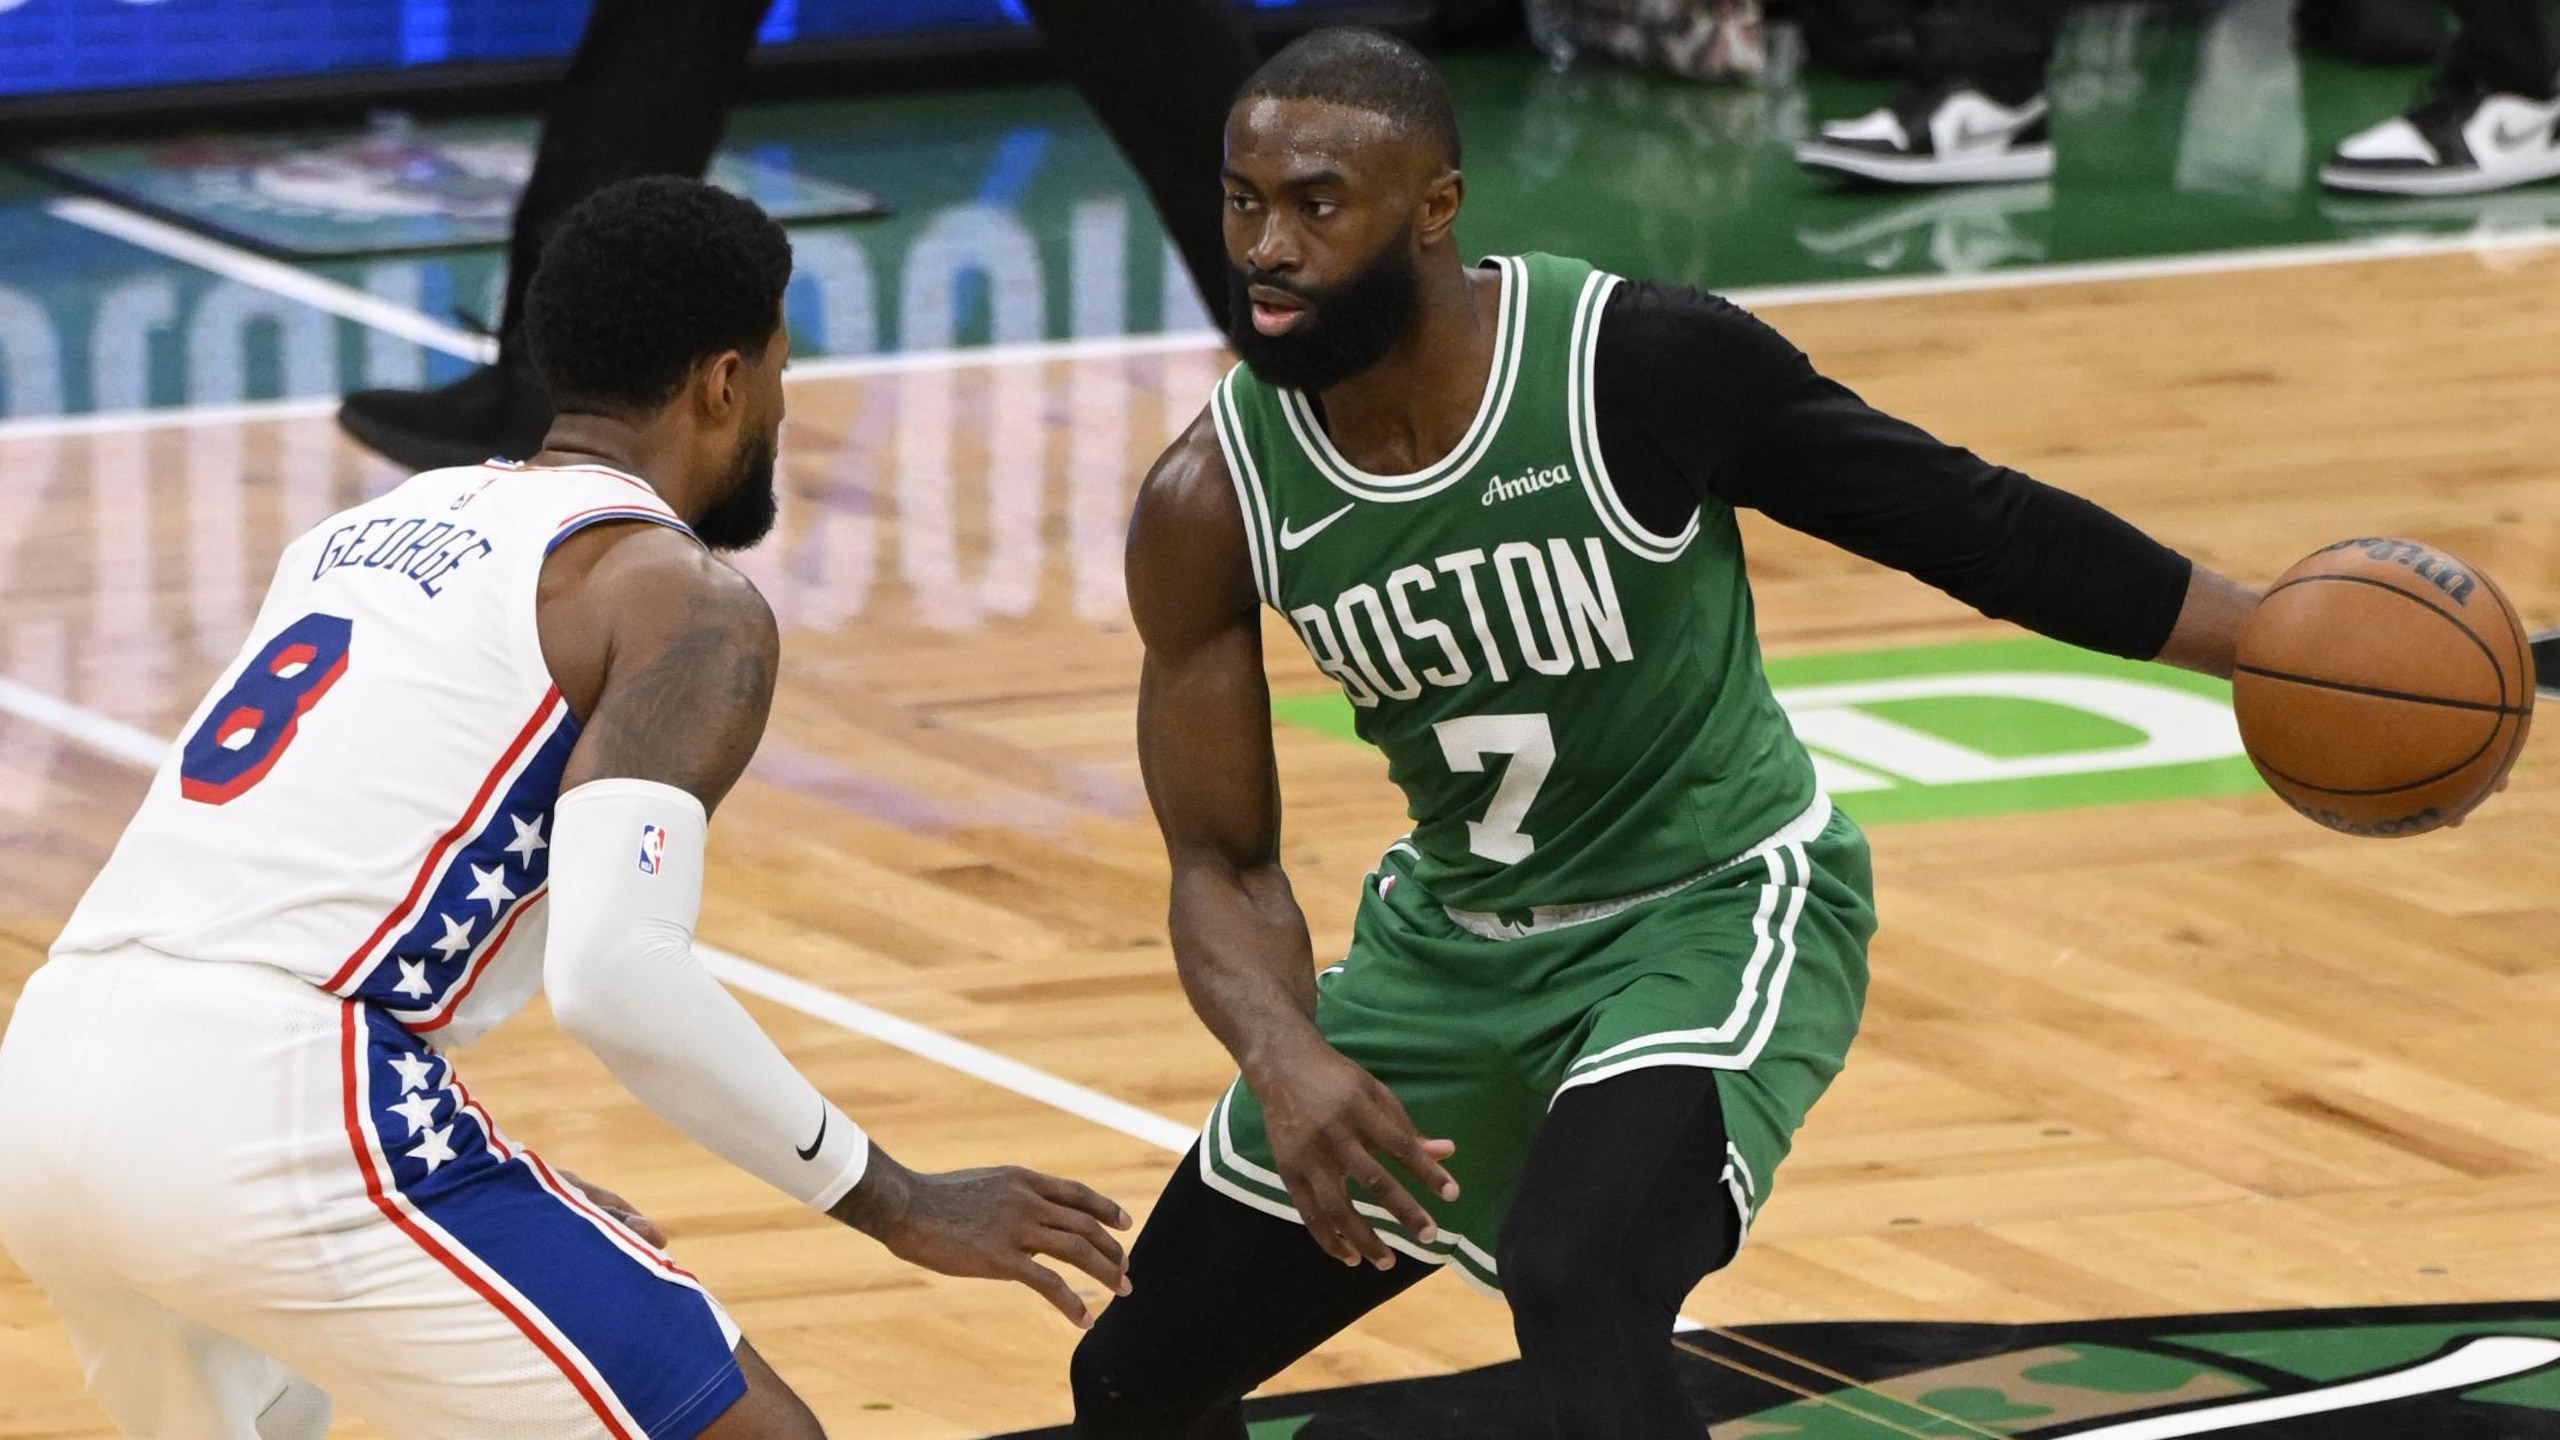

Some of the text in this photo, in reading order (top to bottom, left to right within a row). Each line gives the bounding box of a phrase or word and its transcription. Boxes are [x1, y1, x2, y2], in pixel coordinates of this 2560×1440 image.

[1481, 464, 1572, 507] Amica
[312, 517, 493, 599] GEORGE
[2326, 537, 2477, 608] Wil
[1291, 536, 1635, 709] BOSTON
[180, 612, 354, 807] 8
[1432, 712, 1557, 866] 7
